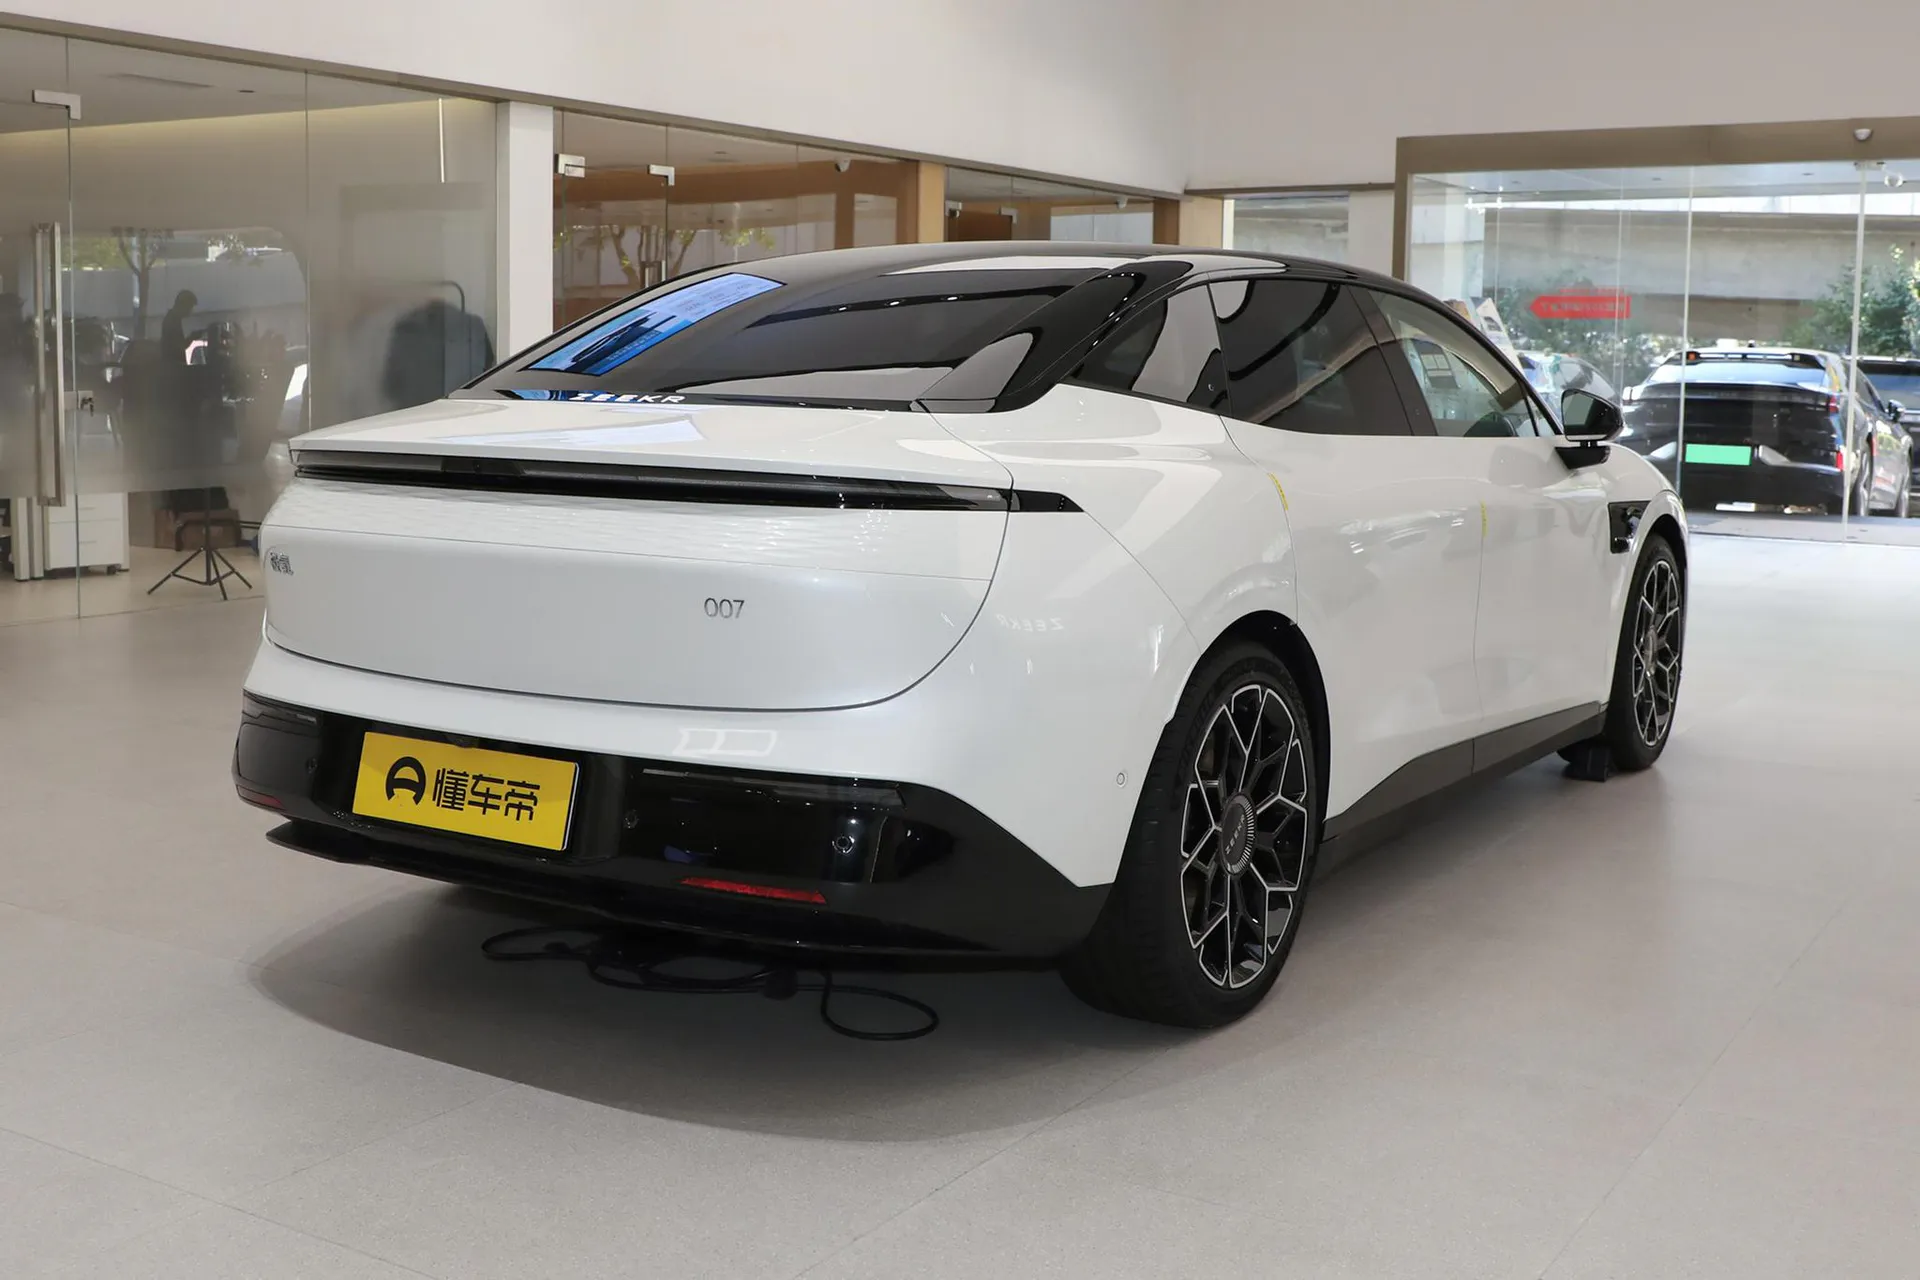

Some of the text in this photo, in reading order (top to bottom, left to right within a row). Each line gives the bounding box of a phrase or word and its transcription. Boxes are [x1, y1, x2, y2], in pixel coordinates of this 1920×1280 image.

[568, 393, 685, 403] ZEEKR
[704, 597, 745, 619] 007
[432, 767, 541, 821] 懂车帝
